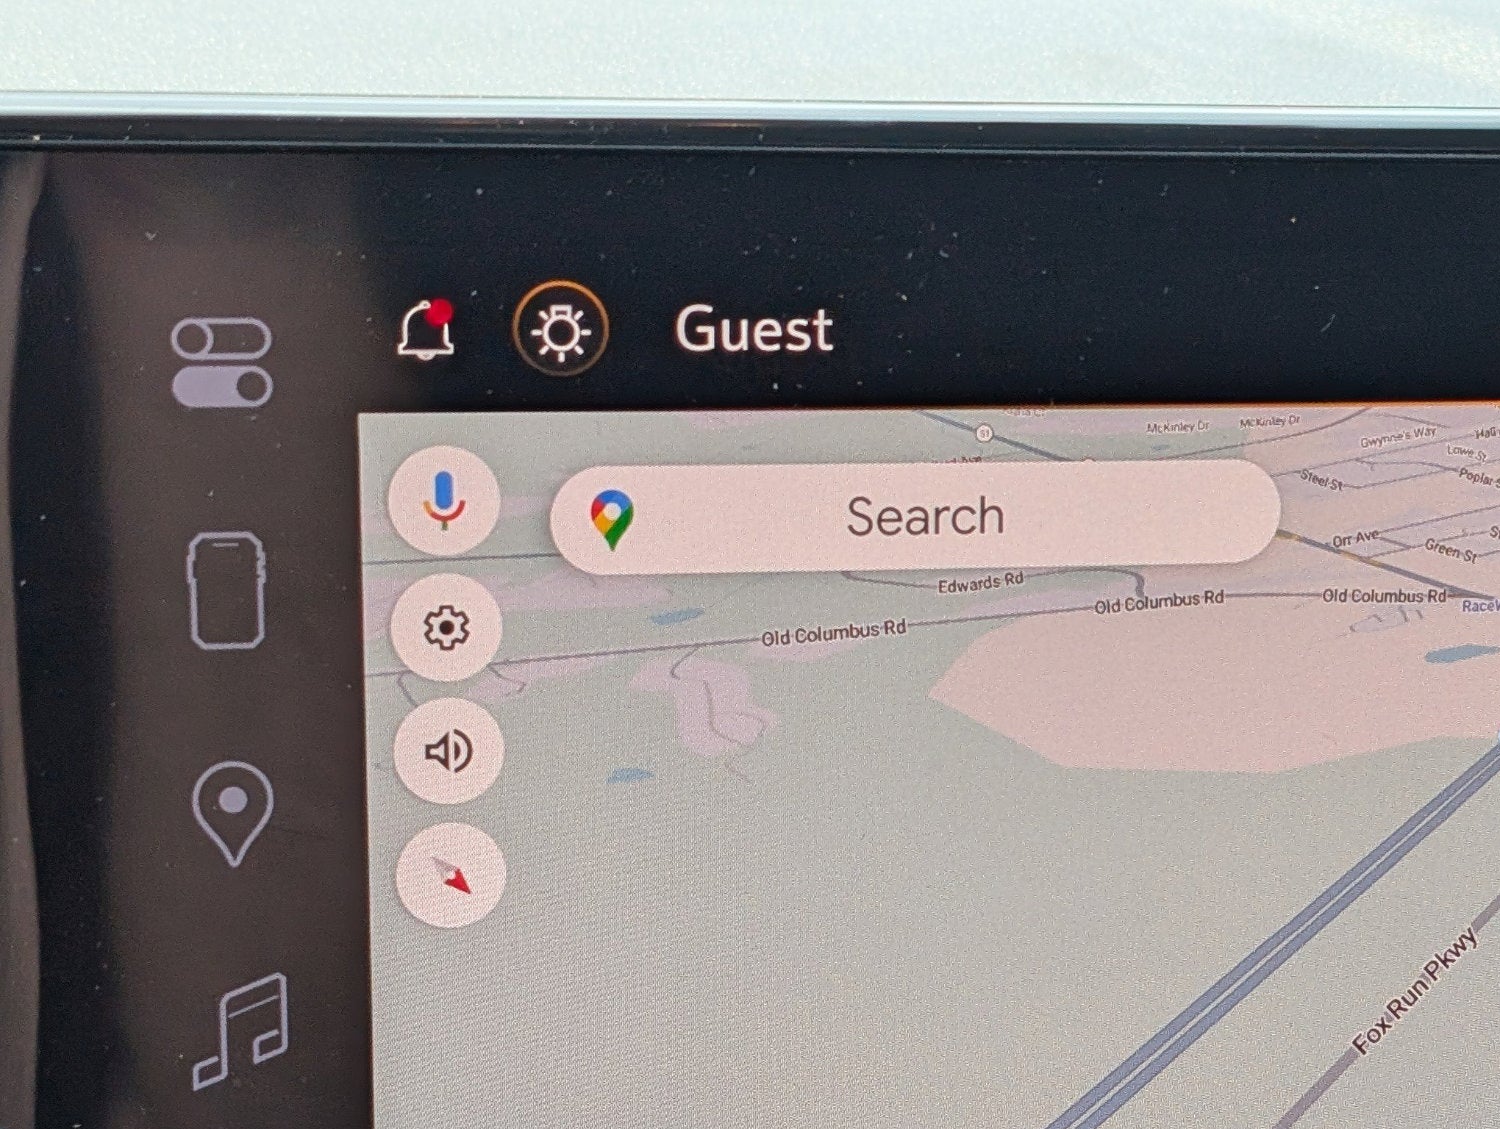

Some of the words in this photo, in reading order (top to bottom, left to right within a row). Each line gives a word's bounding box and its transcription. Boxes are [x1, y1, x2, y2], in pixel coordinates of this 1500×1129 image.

[676, 303, 834, 352] Guest
[1146, 422, 1195, 434] McKinley
[1197, 420, 1210, 431] Dr
[1239, 417, 1287, 430] McKinley
[1288, 415, 1301, 425] Dr
[1413, 426, 1437, 440] Way
[1474, 451, 1487, 463] St
[1300, 469, 1329, 488] Steel
[1330, 477, 1343, 491] St
[1458, 466, 1494, 487] Poplar
[847, 495, 1004, 536] Search
[1332, 534, 1352, 549] Orr
[1356, 529, 1380, 545] Ave
[1424, 537, 1462, 559] Green
[1462, 548, 1479, 565] St
[937, 577, 1000, 595] Edwards
[1003, 570, 1025, 587] Rd
[1095, 599, 1122, 615] Old
[1123, 594, 1202, 613] Columbus
[1203, 590, 1225, 605] Rd
[1322, 588, 1348, 603] Old
[1351, 588, 1424, 604] Columbus
[1427, 588, 1448, 603] Rd
[761, 629, 791, 647] Old
[794, 621, 881, 644] Columbus
[883, 618, 907, 637] Rd
[1351, 1015, 1394, 1056] Fox
[1386, 979, 1430, 1021] Run
[1422, 926, 1478, 982] Pkwy
